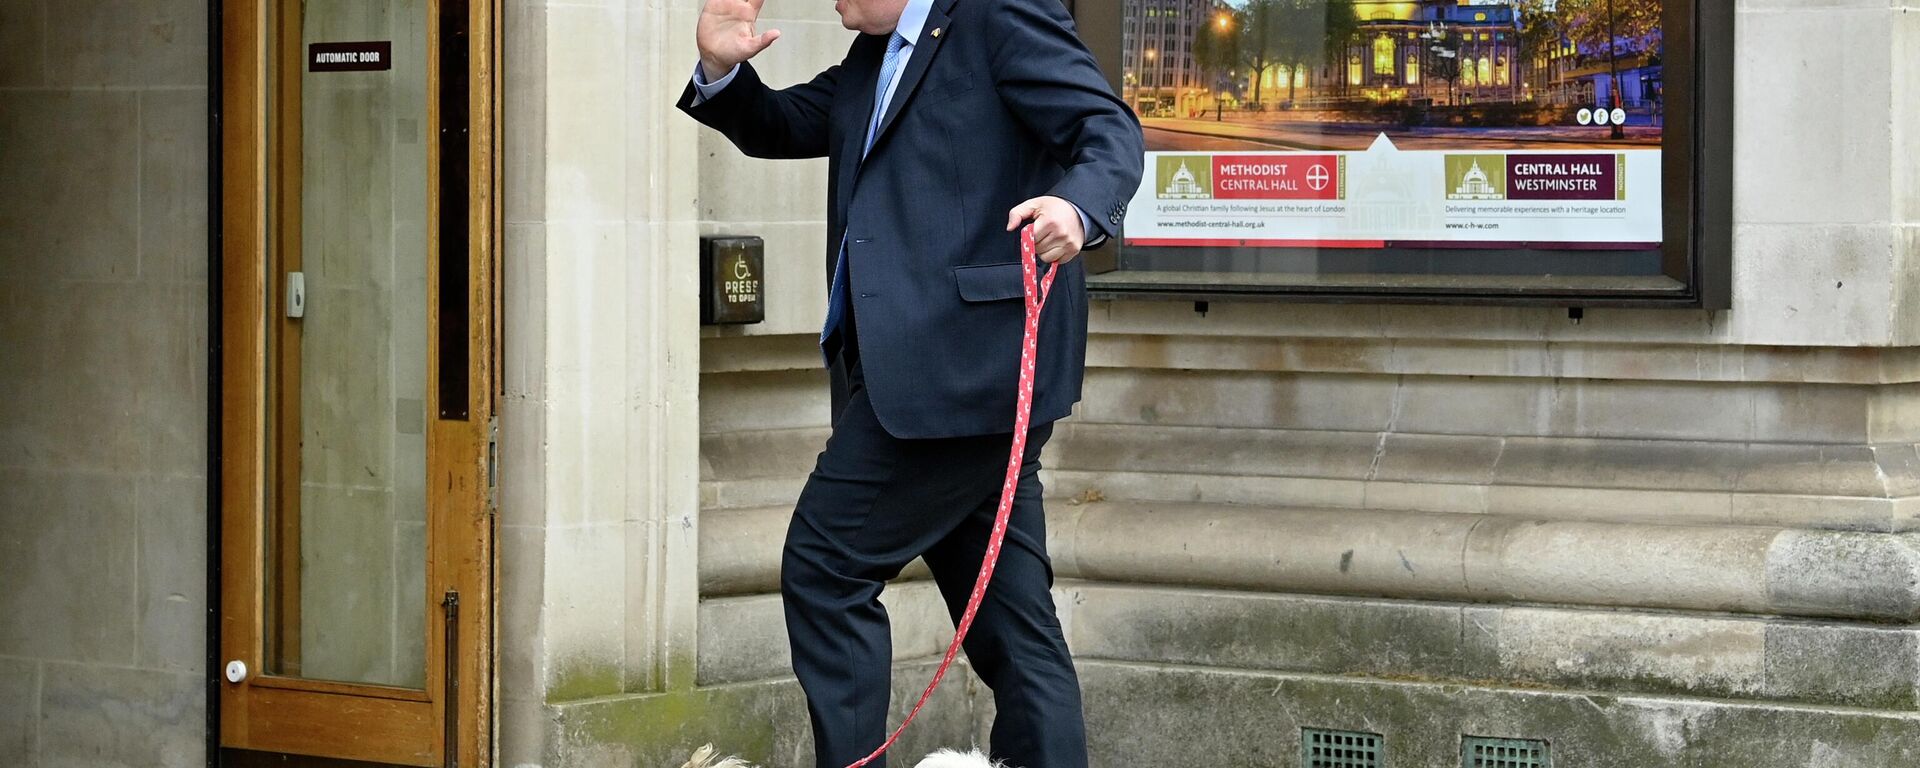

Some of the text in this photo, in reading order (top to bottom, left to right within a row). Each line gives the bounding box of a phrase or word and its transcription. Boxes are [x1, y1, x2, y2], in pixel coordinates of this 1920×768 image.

[316, 52, 380, 63] AUTOMATIC DOOR
[1220, 164, 1287, 176] METHODIST
[1515, 163, 1602, 175] CENTRAL HALL
[1220, 179, 1298, 191] CENTRAL HALL
[1515, 179, 1597, 191] WESTMINSTER
[1162, 204, 1180, 213] global
[1210, 204, 1229, 213] family
[1230, 204, 1258, 213] following
[1259, 205, 1276, 213] Jesus
[1284, 205, 1295, 213] the
[1296, 205, 1313, 213] heart
[1314, 205, 1321, 213] of
[1322, 205, 1345, 213] London
[1445, 205, 1476, 214] Delivering
[1477, 205, 1513, 213] memorable
[1514, 206, 1550, 215] experiences
[1571, 206, 1598, 215] heritage
[1157, 220, 1265, 229] www.methodist-central-hall.org.uk
[725, 280, 758, 294] PRESS
[728, 294, 756, 303] TO OPEN
